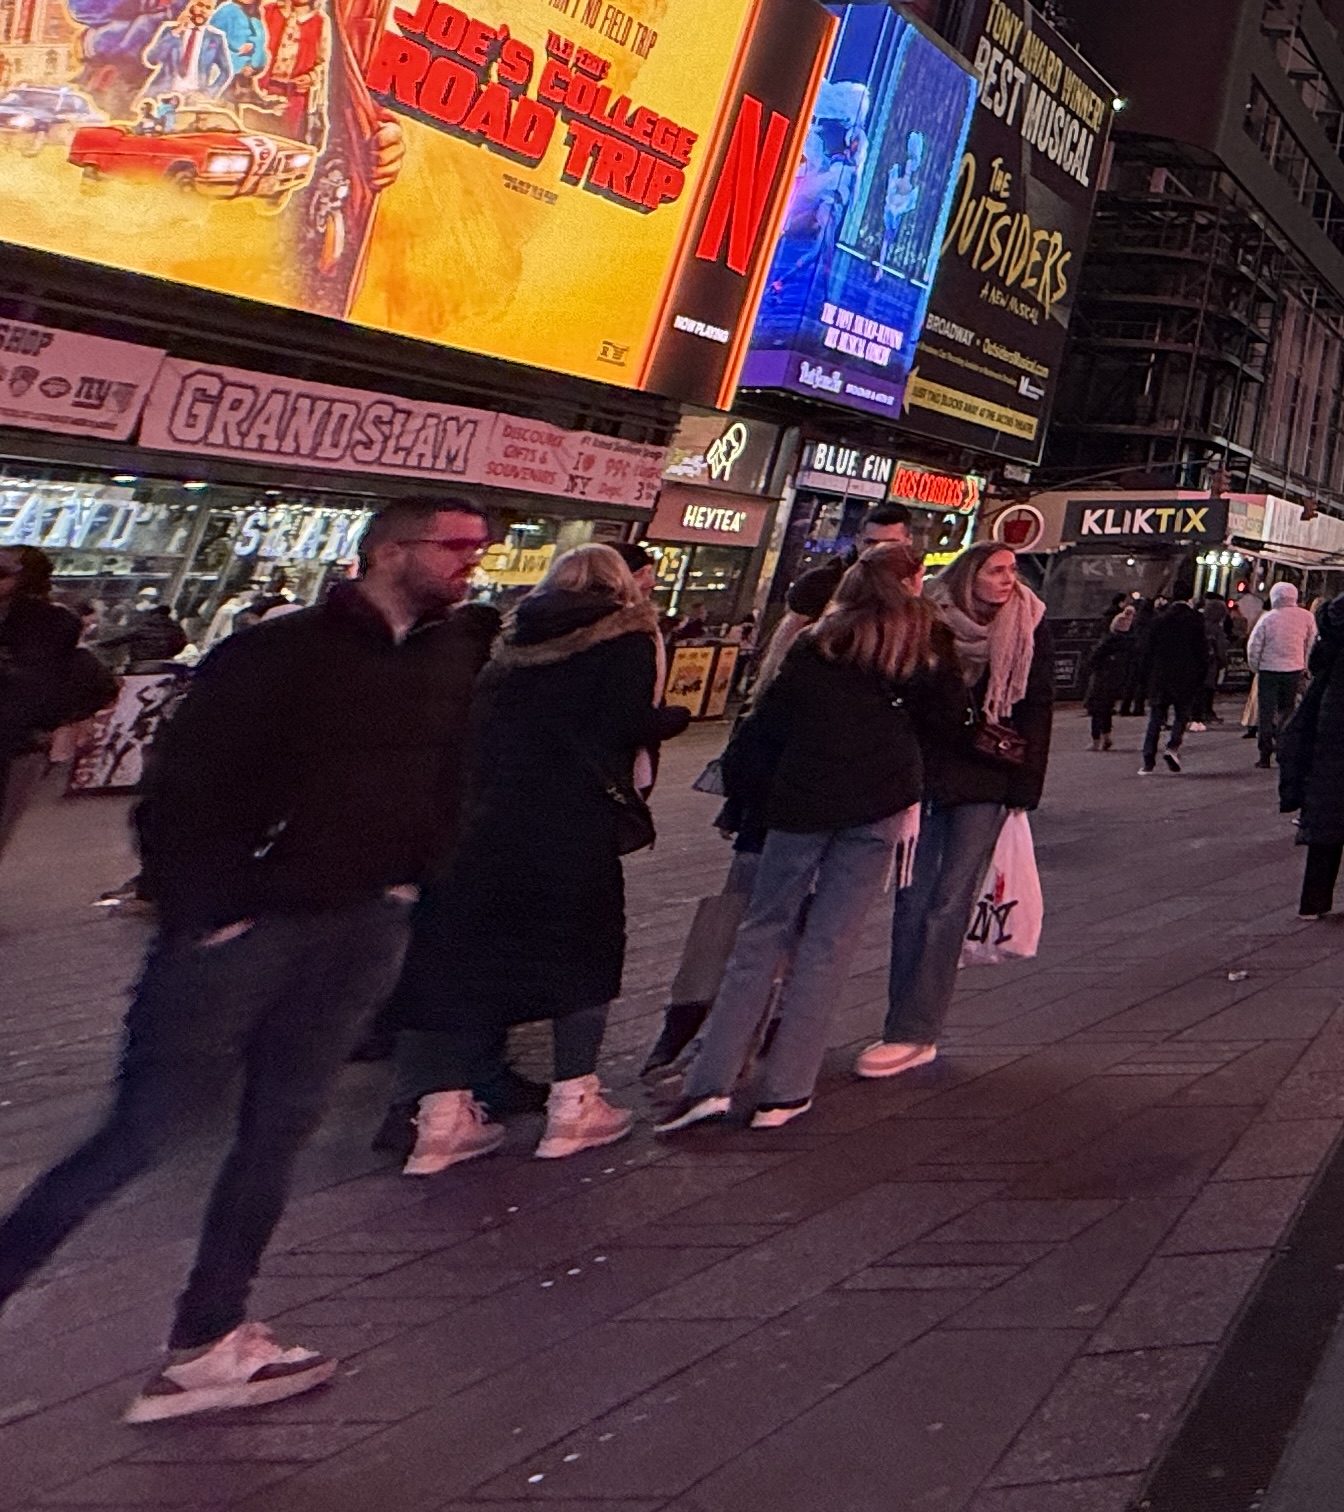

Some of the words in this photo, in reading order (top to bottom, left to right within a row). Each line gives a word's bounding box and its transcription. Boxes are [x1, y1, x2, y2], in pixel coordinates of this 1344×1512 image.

[602, 4, 634, 46] FIELD
[631, 21, 658, 60] TRIP
[1019, 29, 1063, 93] AWARD
[1060, 68, 1105, 134] WINNER!
[365, 29, 557, 168] ROAD
[561, 119, 687, 215] TRIP
[537, 57, 699, 166] COLLEGE
[974, 35, 1028, 127] BEST
[1021, 82, 1094, 188] MUSICAL
[695, 91, 790, 276] N
[991, 156, 1012, 198] THE
[940, 151, 1072, 321] OUTSIDERS
[980, 281, 990, 300] A
[989, 287, 1008, 308] NEW
[1008, 294, 1040, 326] MUSICAL
[674, 314, 697, 334] NOW
[696, 321, 729, 343] PLAYING
[926, 313, 975, 347] BROADWAY
[485, 460, 557, 485] SOUVENIRS
[813, 443, 857, 476] BLUE
[862, 454, 892, 481] FIN
[563, 473, 593, 496] NY
[893, 469, 917, 498] DOS
[918, 471, 964, 507] CAMINOS
[683, 505, 743, 533] HEYTEA
[1081, 507, 1209, 535] KLIKTIX
